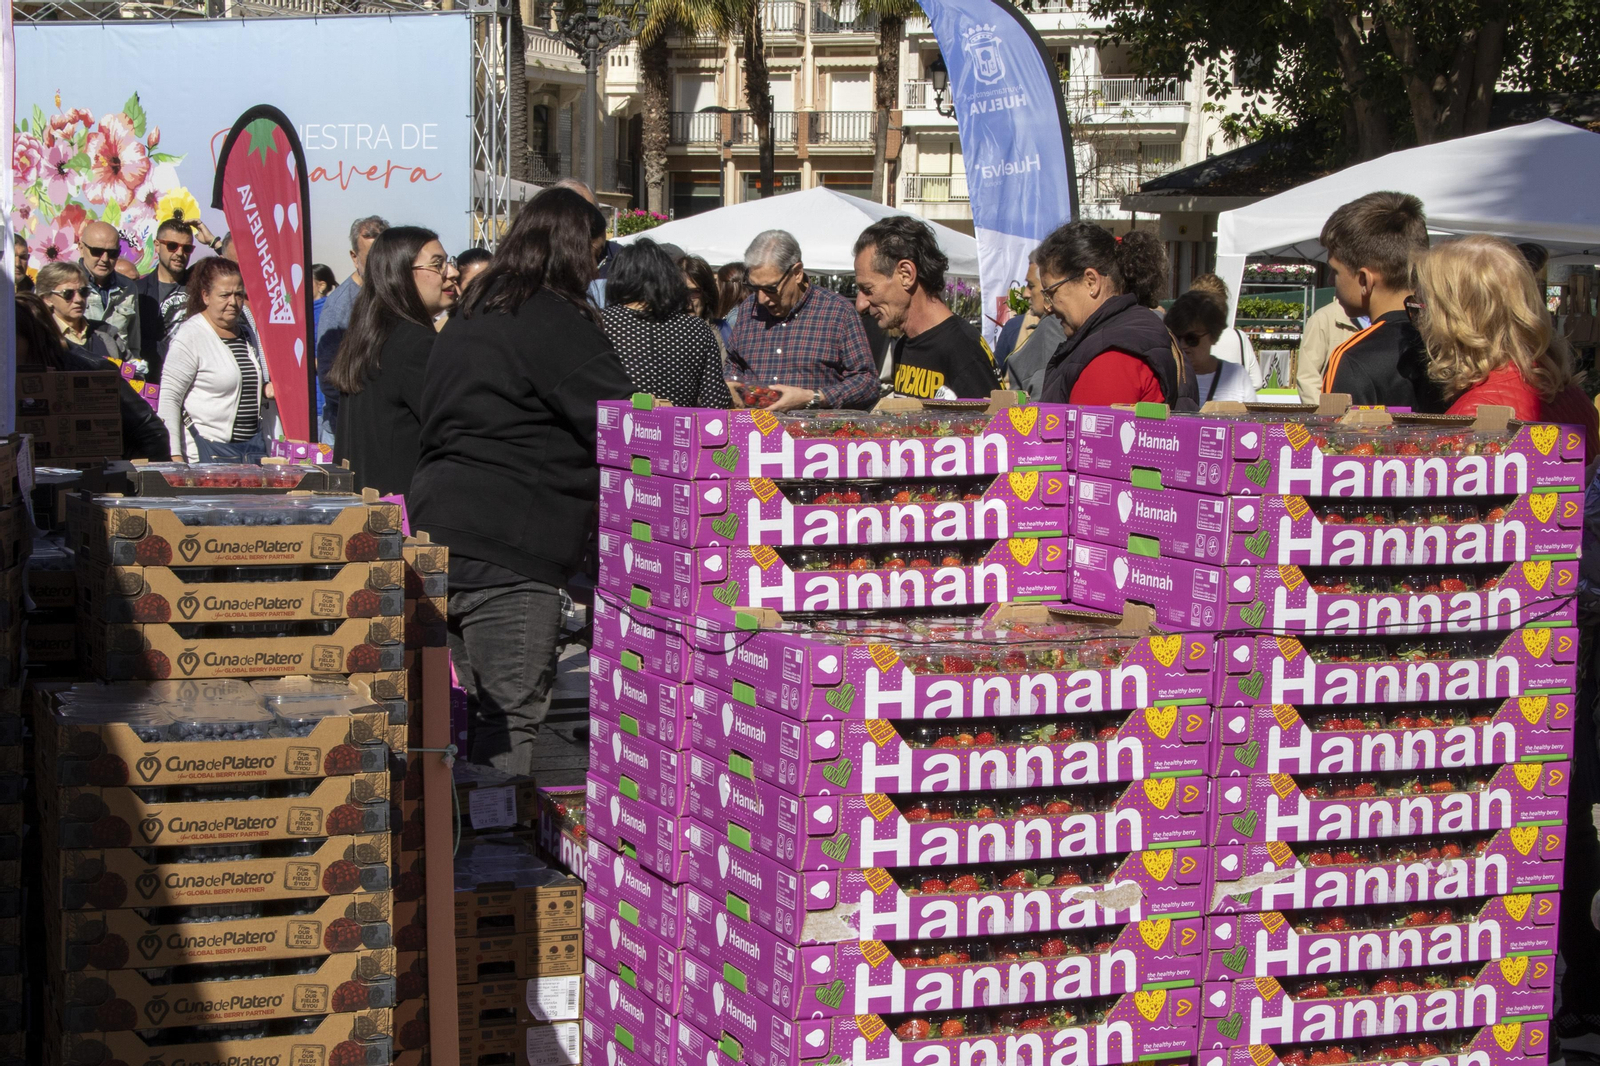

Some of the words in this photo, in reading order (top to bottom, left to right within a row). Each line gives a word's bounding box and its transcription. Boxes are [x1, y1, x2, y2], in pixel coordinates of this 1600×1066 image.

[402, 124, 438, 150] DE
[308, 159, 442, 190] avera
[634, 422, 662, 441] Hannah
[1138, 431, 1180, 452] Hannah
[635, 488, 662, 508] Hannah
[1135, 501, 1177, 523] Hannah
[634, 556, 662, 574] Hannah
[1131, 567, 1173, 591] Hannah
[737, 645, 769, 670] Hannah
[623, 680, 648, 705] Hannah
[735, 716, 766, 744] Hannah
[623, 744, 649, 770] Hannah
[621, 807, 647, 835] Hannah
[625, 869, 651, 898] Hannah
[730, 859, 762, 890] Hannah
[621, 931, 647, 961] Hannah
[728, 927, 760, 961] Hannah
[619, 993, 645, 1024] Hannah
[726, 998, 757, 1032] Hannah
